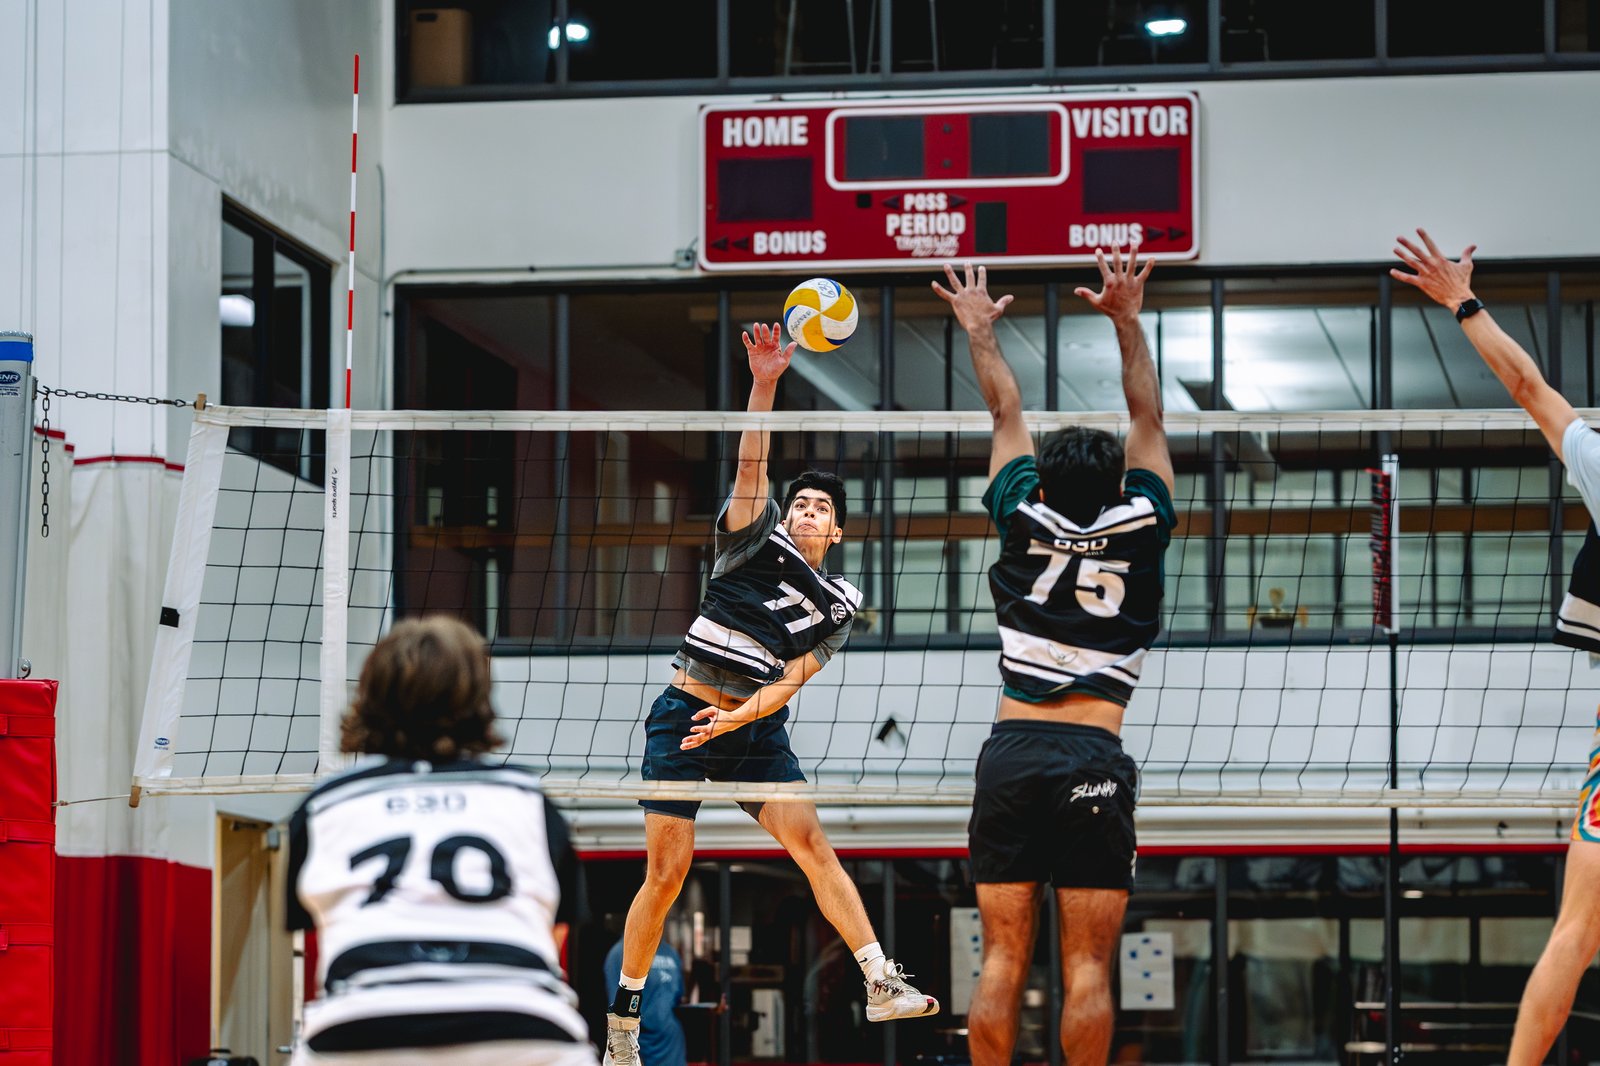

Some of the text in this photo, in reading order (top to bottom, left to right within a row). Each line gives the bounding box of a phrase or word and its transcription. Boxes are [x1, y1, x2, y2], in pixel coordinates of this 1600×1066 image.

[722, 115, 809, 147] HOME
[1071, 105, 1189, 138] VISITOR
[903, 192, 948, 211] POSS
[886, 212, 966, 237] PERIOD
[1069, 223, 1143, 248] BONUS
[753, 230, 827, 254] BONUS
[1023, 538, 1132, 619] 75
[347, 833, 512, 908] 70
